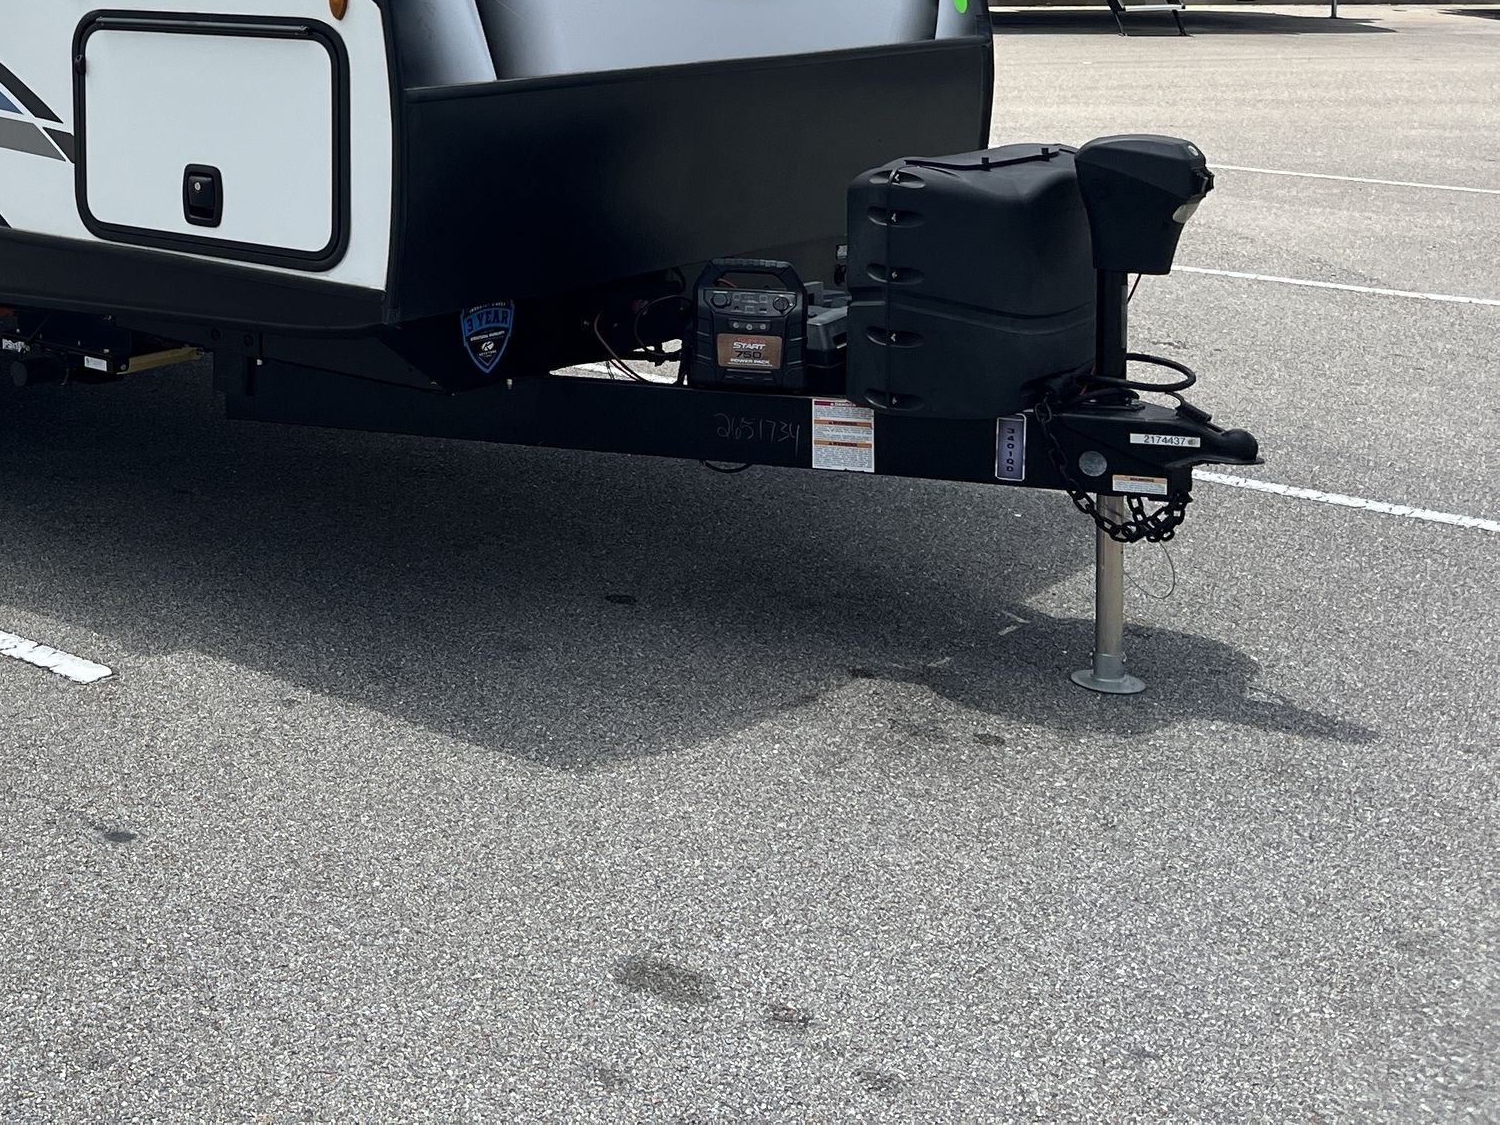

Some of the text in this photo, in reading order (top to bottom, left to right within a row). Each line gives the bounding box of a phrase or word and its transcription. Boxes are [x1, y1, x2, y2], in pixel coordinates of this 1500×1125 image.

[732, 341, 766, 350] START
[734, 350, 762, 358] 750
[1143, 435, 1186, 446] 2174437
